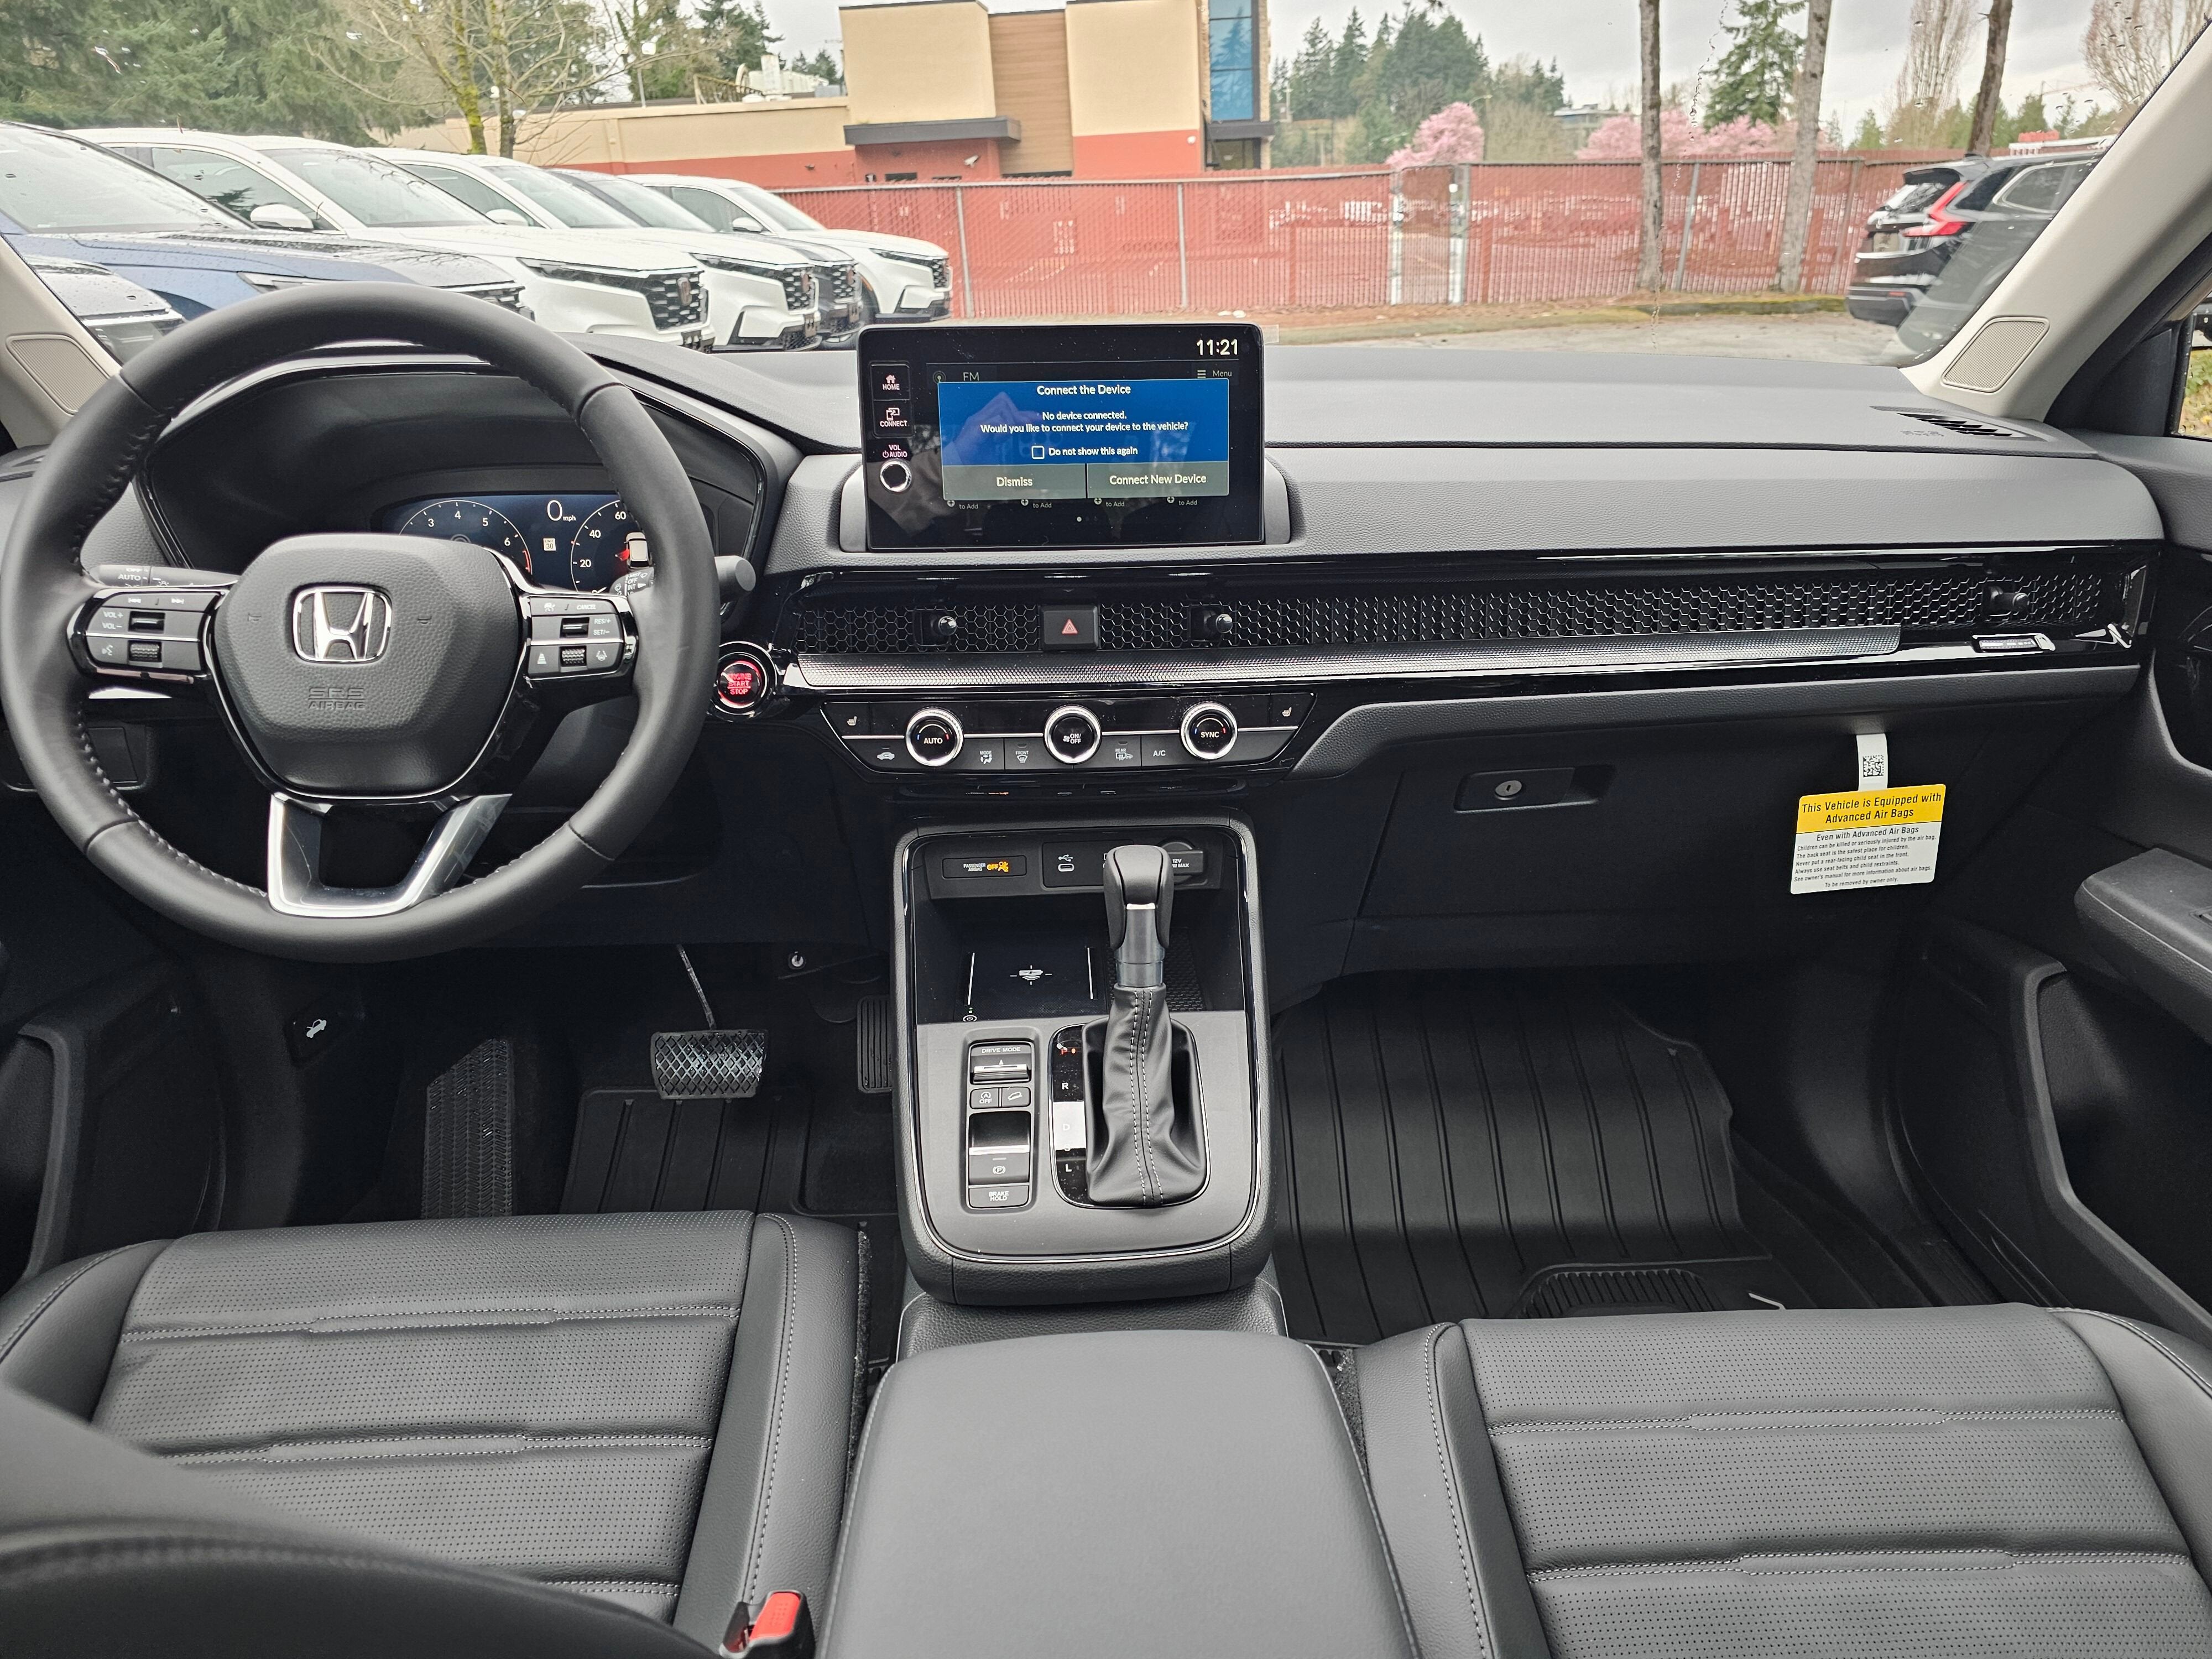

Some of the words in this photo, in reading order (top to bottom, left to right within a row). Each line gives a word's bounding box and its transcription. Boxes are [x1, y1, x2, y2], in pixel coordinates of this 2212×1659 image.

[1196, 338, 1238, 356] 11:21
[963, 372, 979, 381] FM
[1037, 385, 1078, 395] Connect
[1079, 385, 1095, 394] the
[1098, 384, 1131, 394] Device
[1042, 411, 1055, 420] No
[1056, 411, 1082, 420] device
[1083, 410, 1127, 420] connected.
[980, 424, 1008, 433] Would
[1009, 425, 1024, 434] you
[1026, 424, 1040, 432] like
[1041, 424, 1050, 432] to
[1052, 424, 1084, 432] connect
[1085, 424, 1104, 432] your
[1105, 422, 1131, 431] device
[1132, 422, 1141, 431] to
[1142, 422, 1156, 431] the
[1157, 421, 1189, 430] vehicle?
[1048, 448, 1061, 456] Do
[1062, 447, 1077, 456] not
[1078, 447, 1099, 456] show
[1100, 446, 1115, 455] this
[1117, 446, 1138, 456] again
[996, 477, 1033, 487] Dismiss
[1109, 475, 1149, 485] Connect
[1150, 474, 1172, 484] New
[1175, 474, 1207, 483] Device
[455, 510, 461, 520] 4
[547, 500, 563, 521] 0
[614, 511, 627, 520] 60
[427, 518, 434, 527] 3
[482, 518, 489, 526] 5
[589, 530, 601, 539] 40
[504, 537, 511, 546] 6
[580, 559, 592, 568] 20
[309, 687, 365, 700] SRS
[309, 701, 366, 710] AIRBAG
[1802, 804, 1821, 813] This
[1825, 800, 1859, 811] Vehicle
[1863, 799, 1871, 807] is
[1874, 794, 1918, 807] Equipped
[1922, 793, 1941, 802] with
[1825, 811, 1871, 823] Advanced
[1874, 810, 1888, 819] Air
[1891, 808, 1914, 820] Bags
[1852, 829, 1887, 838] Advanced
[1065, 1164, 1072, 1172] L
